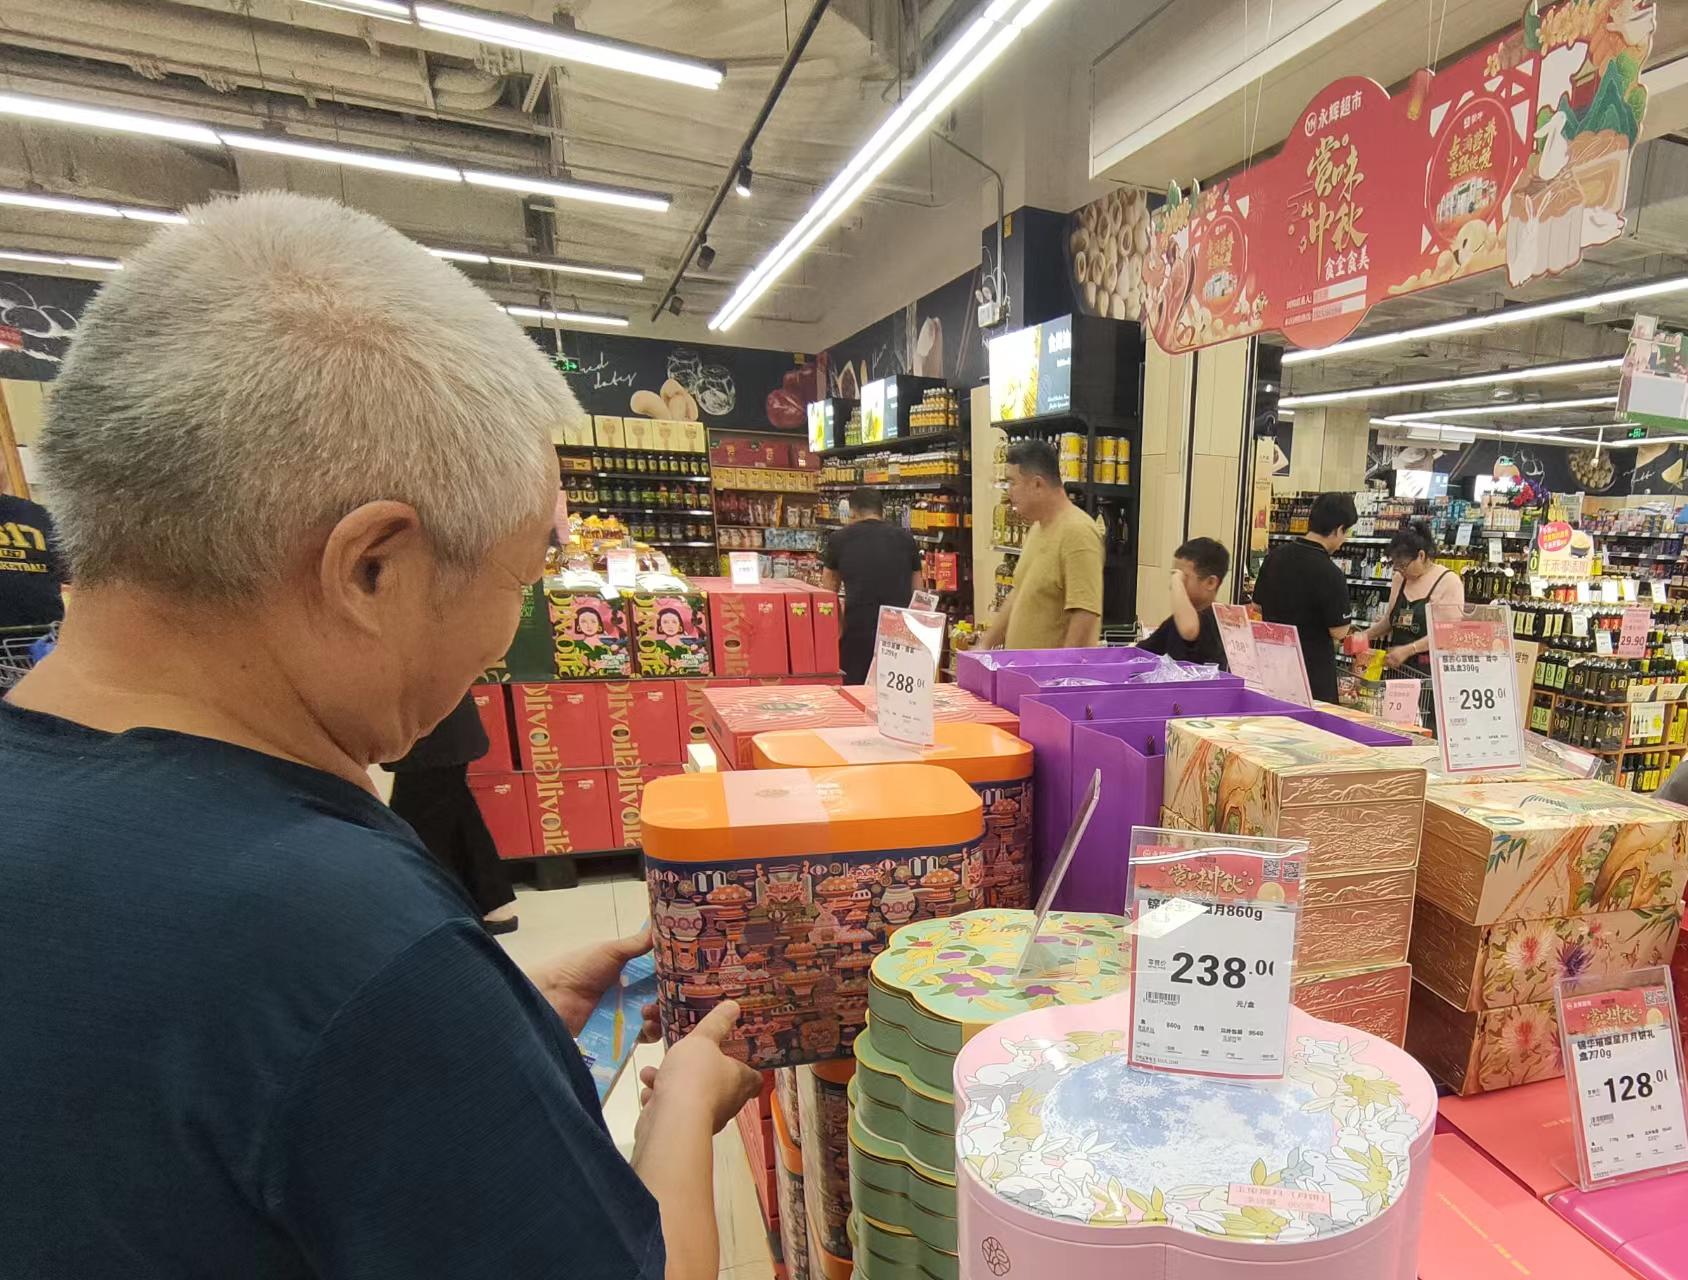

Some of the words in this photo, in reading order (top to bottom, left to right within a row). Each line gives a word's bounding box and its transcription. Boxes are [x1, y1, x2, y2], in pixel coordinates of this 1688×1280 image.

[1318, 90, 1363, 130] 永辉超市
[1306, 134, 1365, 202] 赏味
[1308, 201, 1369, 281] 中秋
[1324, 244, 1371, 281] 食全食美
[1235, 1000, 1255, 1008] 元/盒
